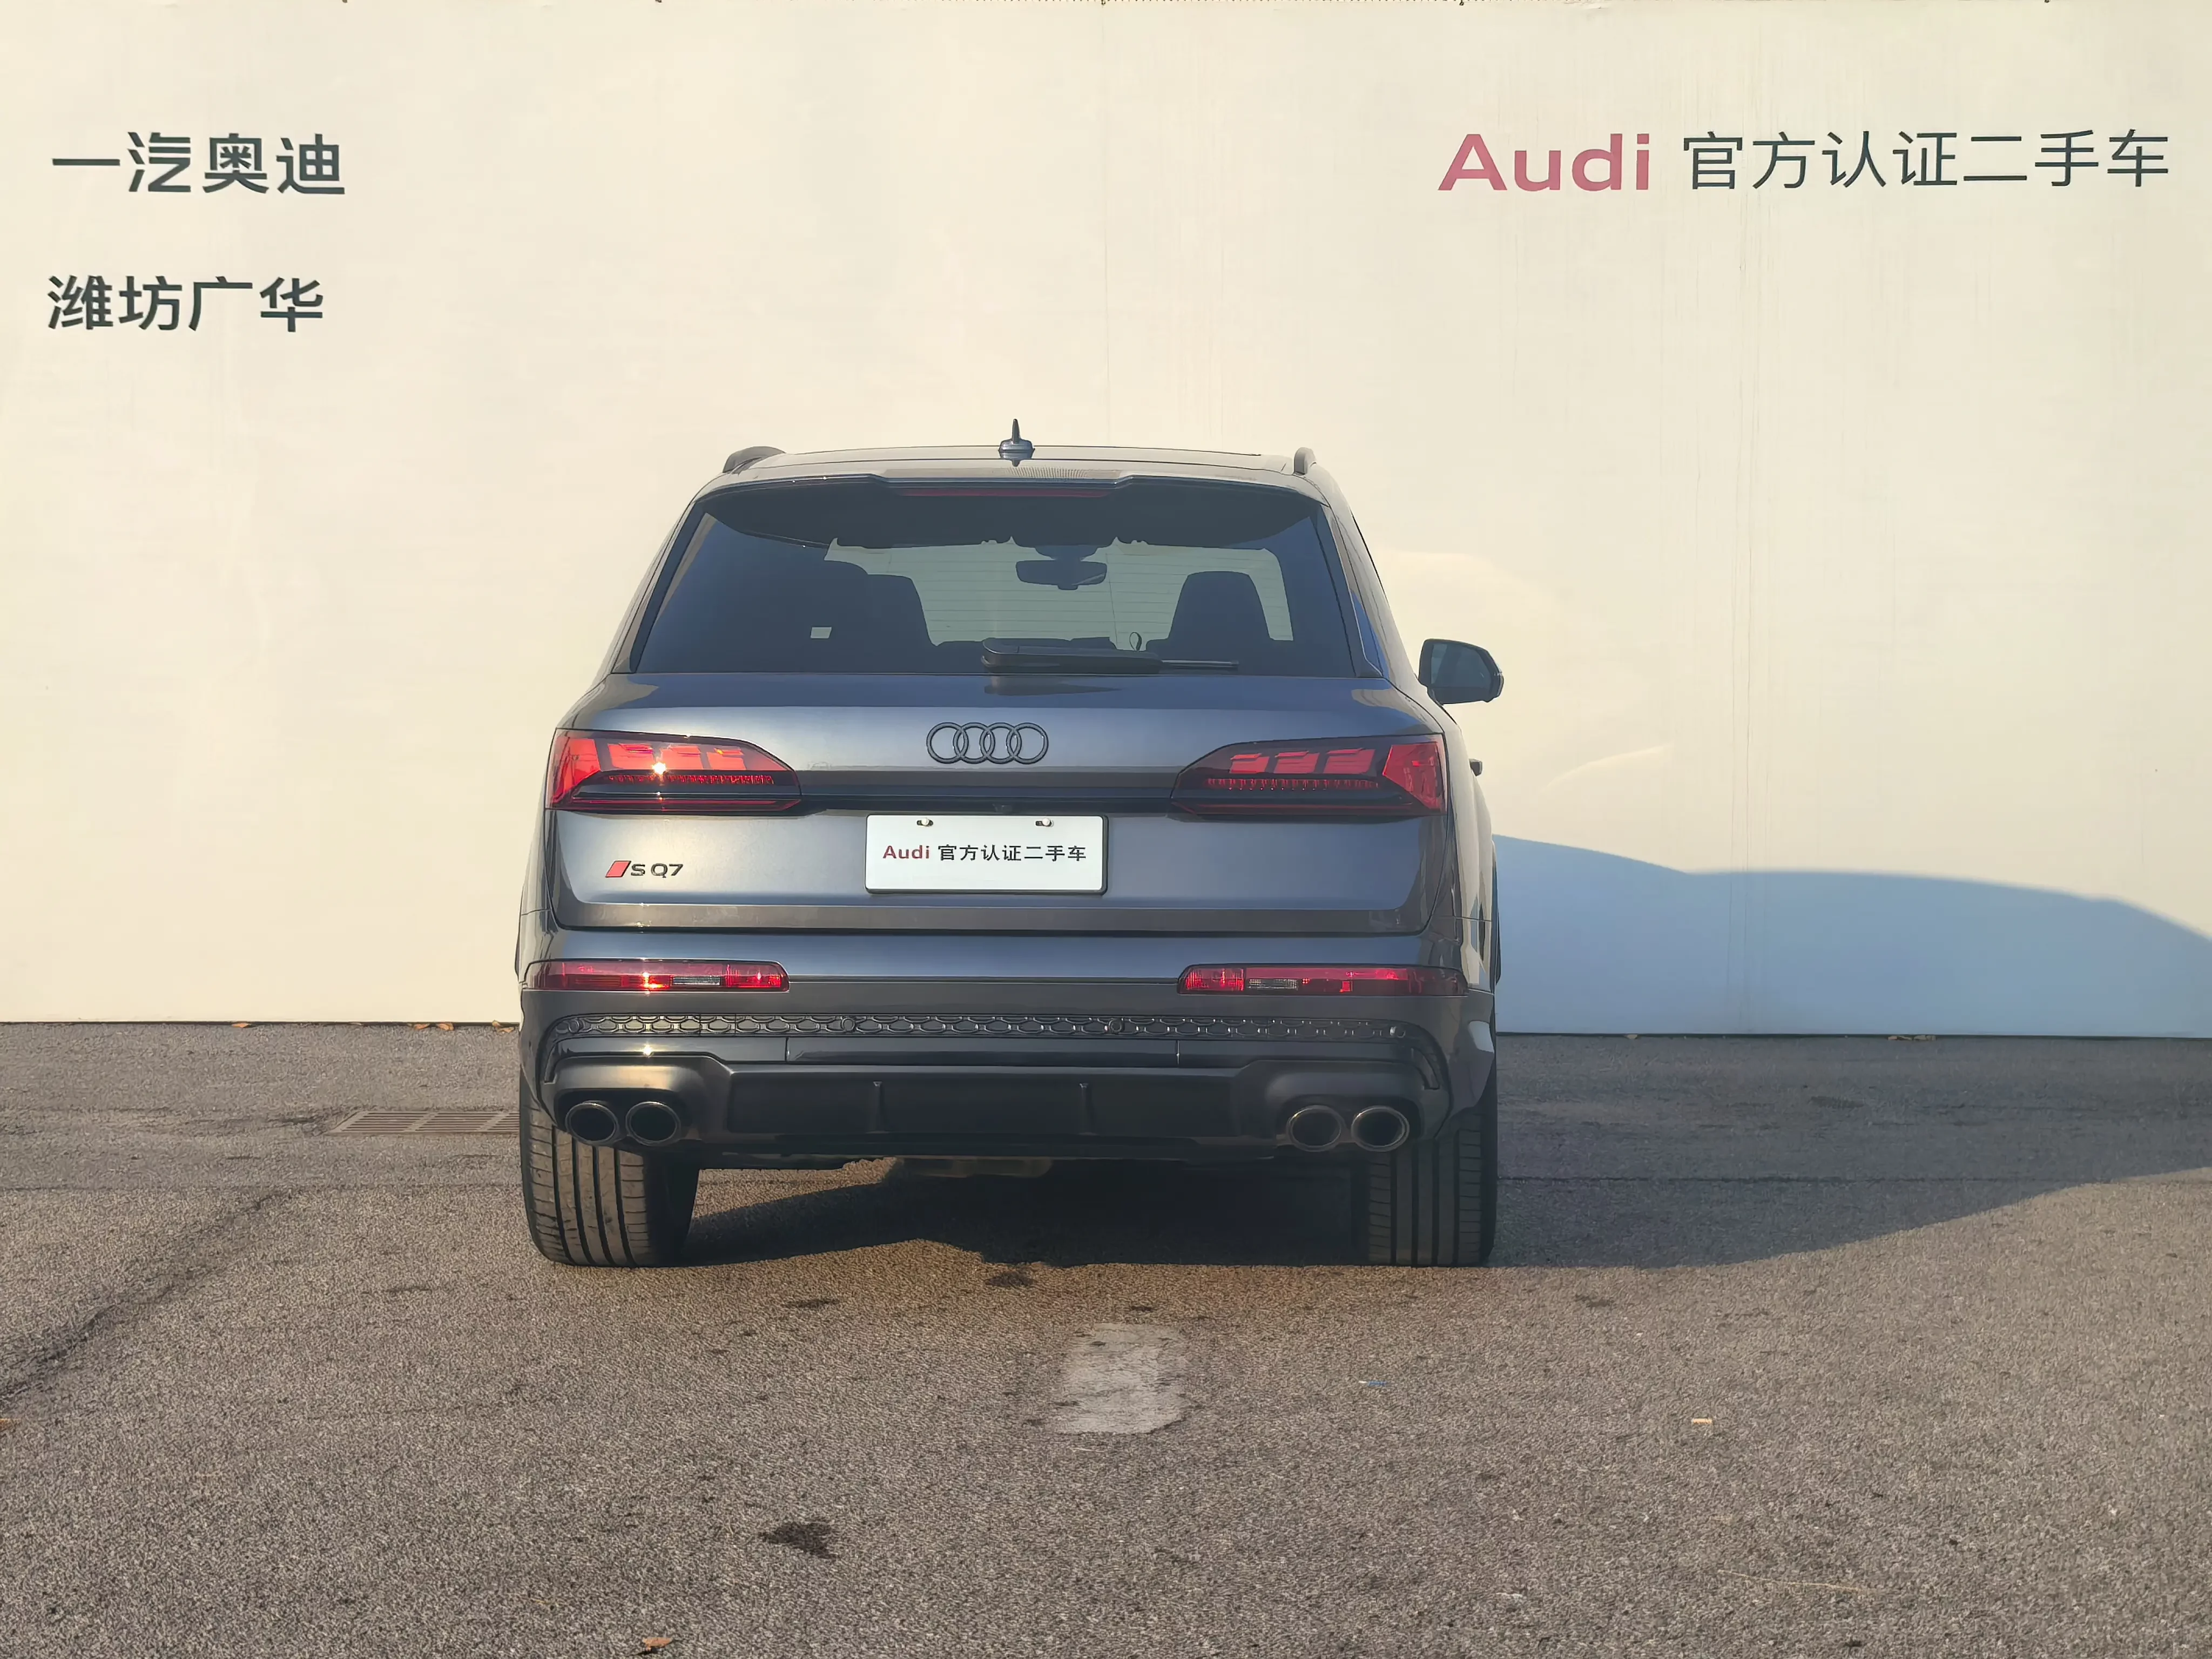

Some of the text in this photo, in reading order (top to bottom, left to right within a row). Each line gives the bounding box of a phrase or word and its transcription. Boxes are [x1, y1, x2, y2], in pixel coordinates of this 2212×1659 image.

[52, 131, 345, 195] 一汽奥迪
[1438, 129, 2169, 192] Audi 官方认证二手车
[48, 275, 323, 333] 潍坊广华
[882, 844, 1087, 862] Audi 官方认证二手车
